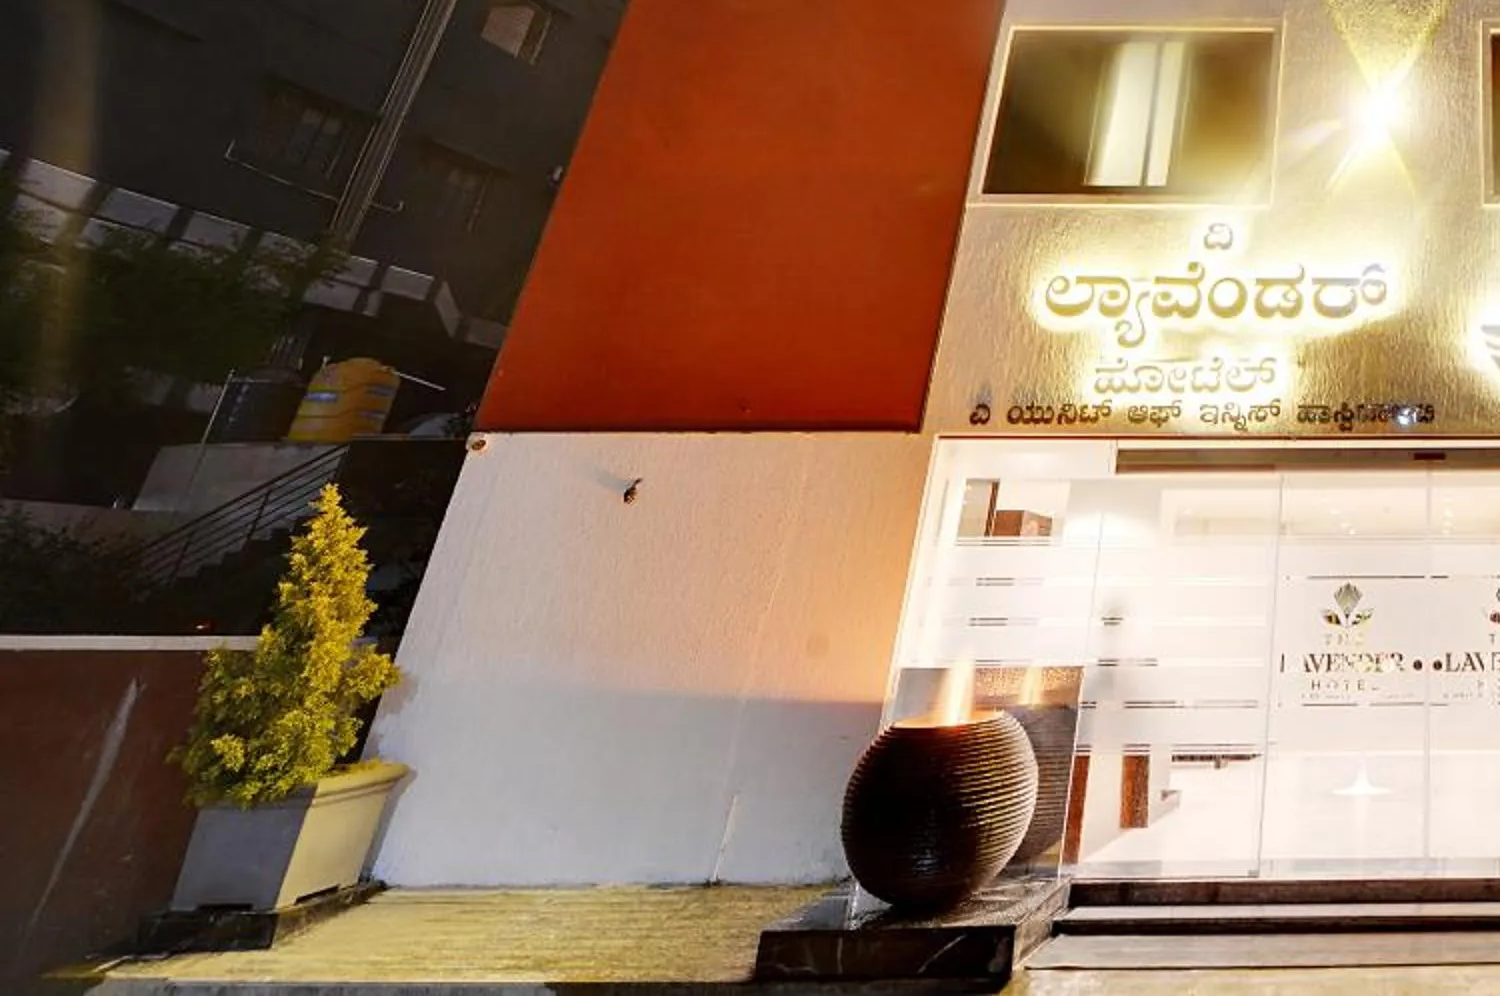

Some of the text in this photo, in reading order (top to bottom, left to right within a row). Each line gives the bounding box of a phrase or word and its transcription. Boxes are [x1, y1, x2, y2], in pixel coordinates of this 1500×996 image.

[1203, 222, 1234, 251] ದಿ
[1045, 261, 1391, 349] ಲ್ಯಾವೆಂಡರ್
[1094, 355, 1278, 395] ಹೋಟೆಲ್
[968, 402, 992, 426] ಎ
[1006, 398, 1113, 426] ಯುನಿಟ್
[1127, 398, 1183, 428] ಆಫ್
